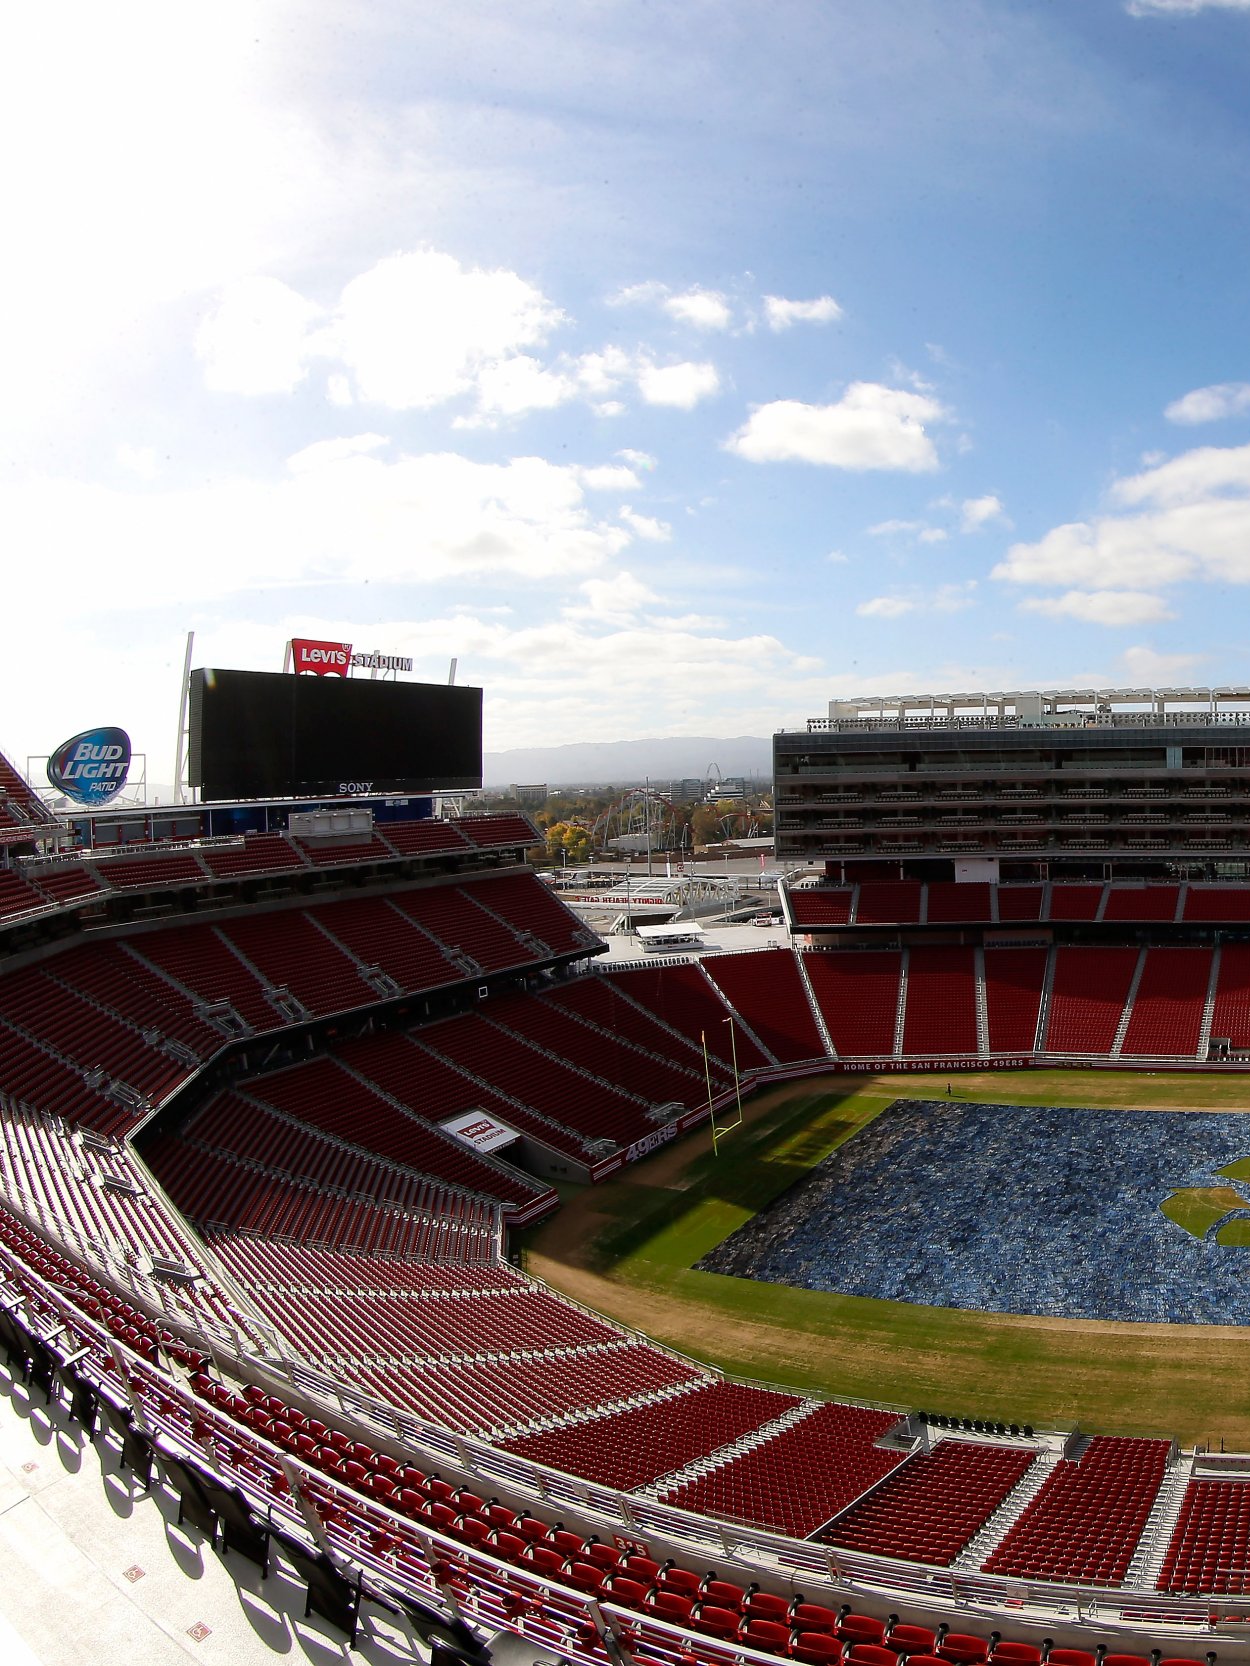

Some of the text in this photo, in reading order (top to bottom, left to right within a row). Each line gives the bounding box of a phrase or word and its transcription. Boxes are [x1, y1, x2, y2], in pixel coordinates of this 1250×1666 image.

[353, 653, 413, 671] STADIUM
[73, 743, 123, 761] BUD
[62, 762, 128, 780] LIGHT
[89, 781, 117, 792] PATIO
[339, 782, 373, 793] SONY
[843, 1063, 871, 1071] HOME
[890, 1062, 908, 1070] THE
[933, 1060, 990, 1069] FRANCISCO
[992, 1059, 1024, 1067] 49ERS
[474, 1128, 507, 1146] STADIUM
[626, 1122, 678, 1162] 49ERS
